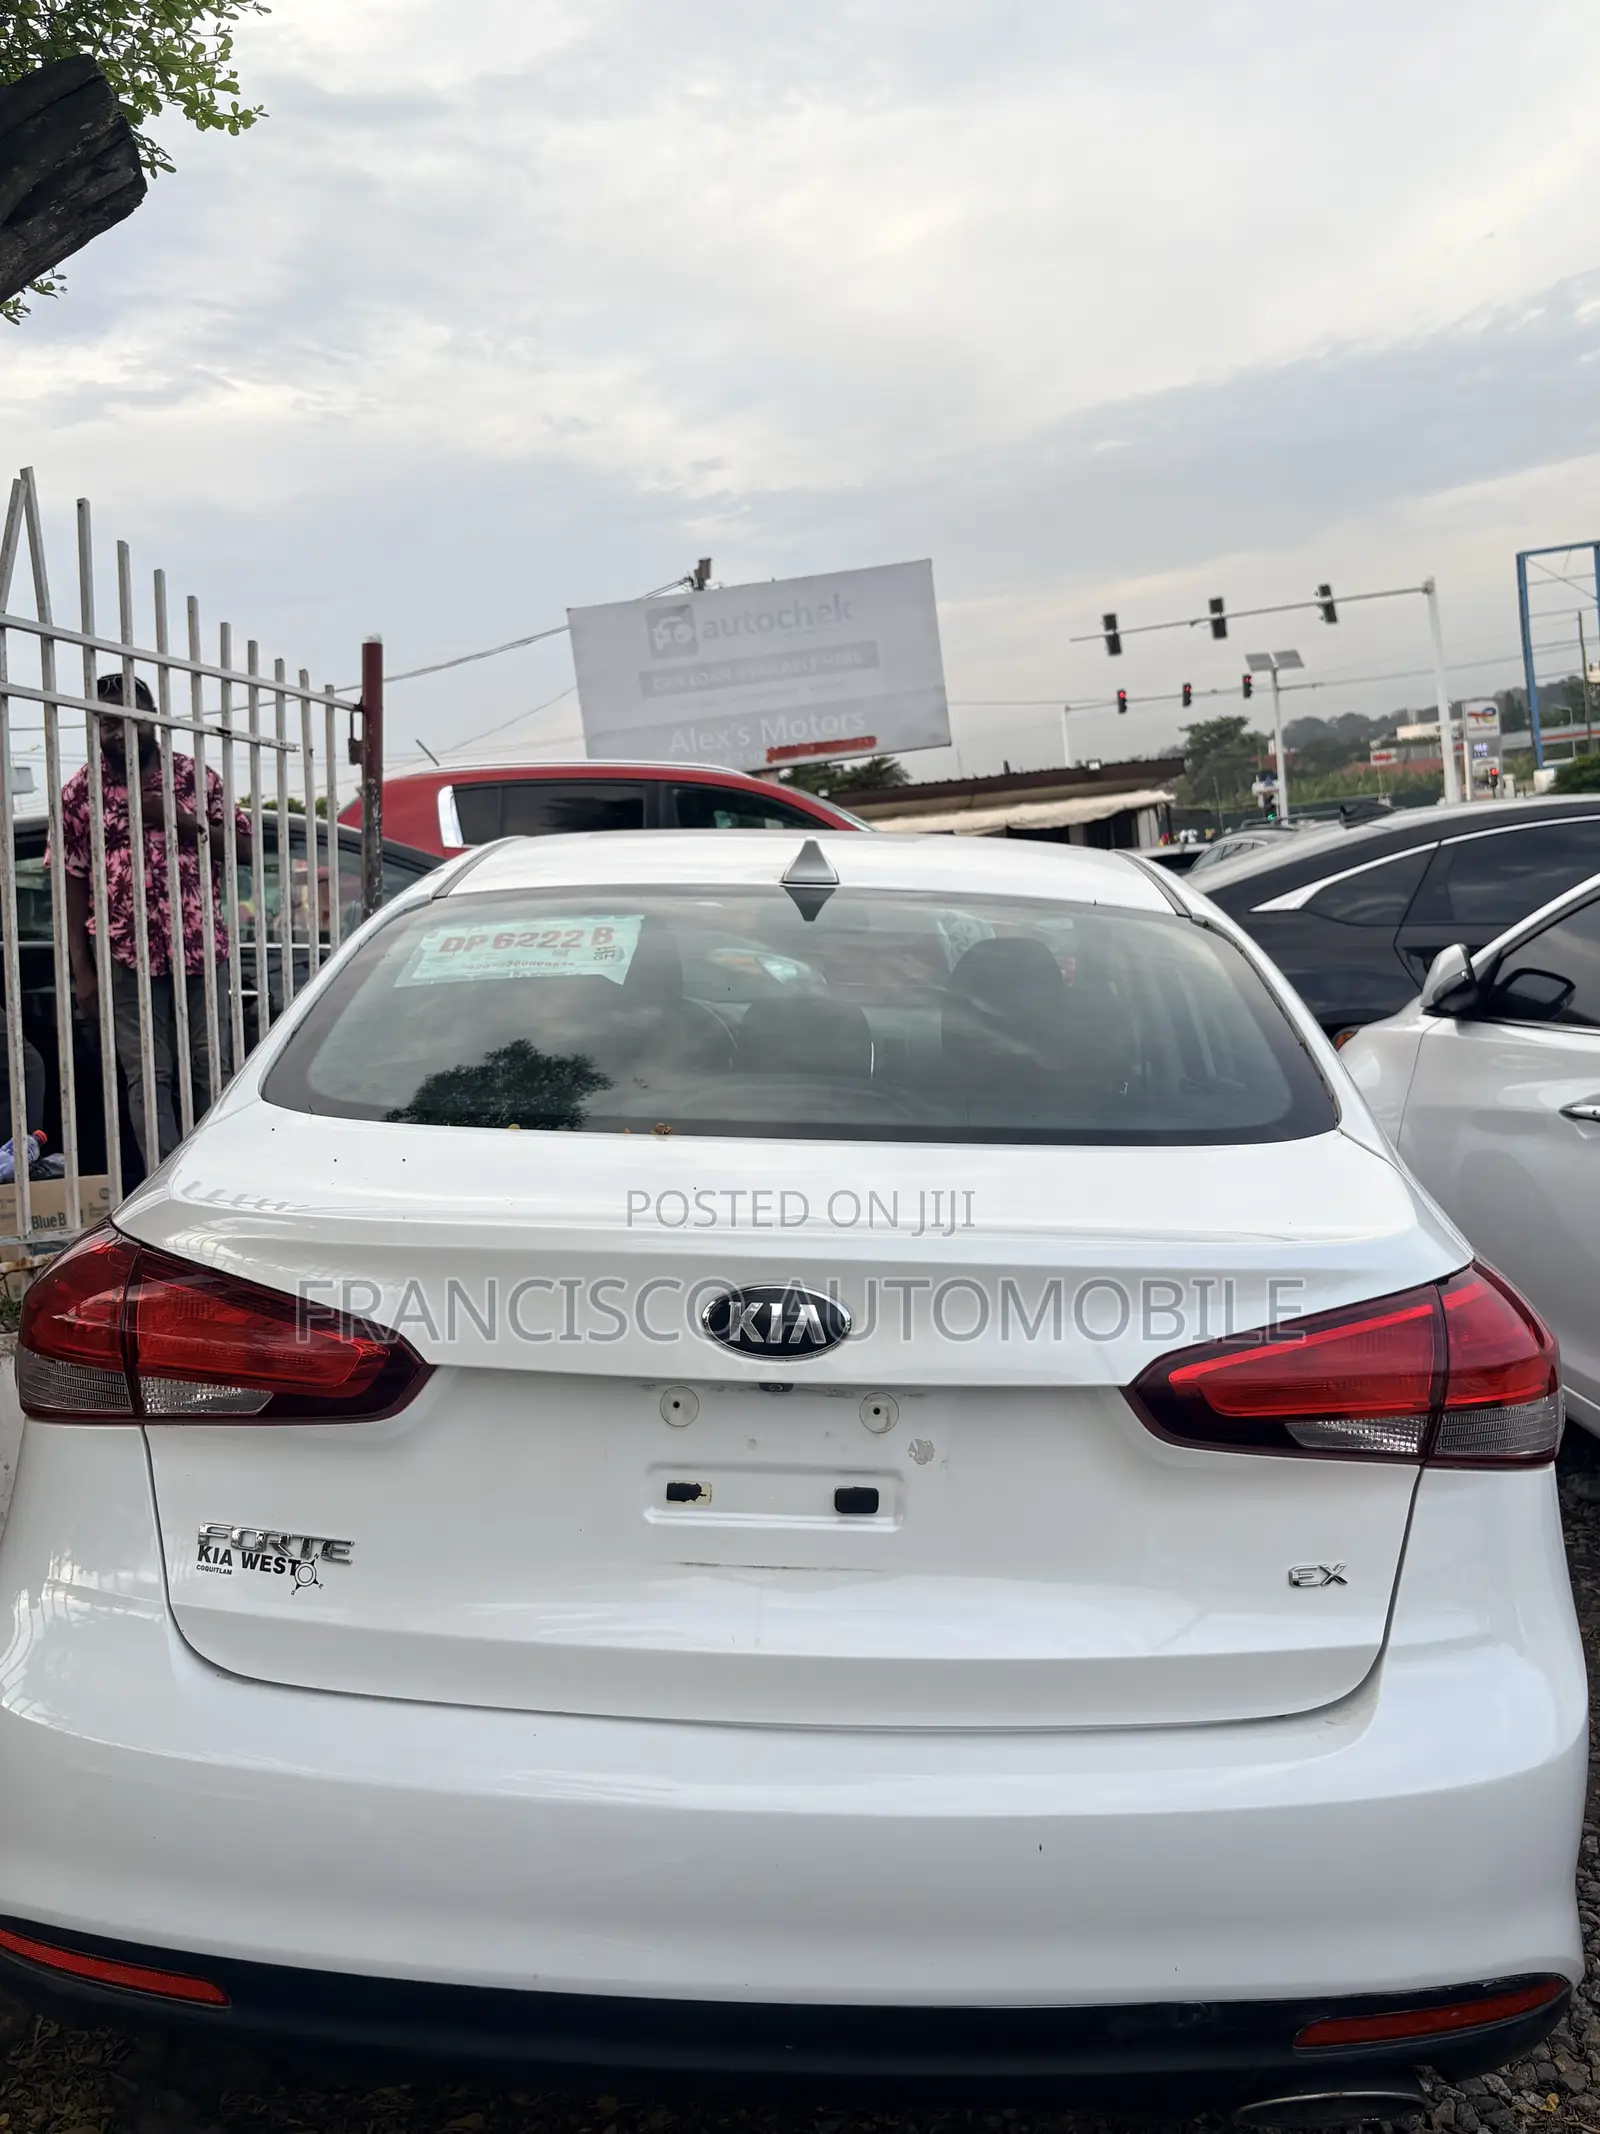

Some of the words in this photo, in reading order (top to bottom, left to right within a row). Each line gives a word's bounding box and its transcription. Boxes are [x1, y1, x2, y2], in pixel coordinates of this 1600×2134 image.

[702, 594, 852, 640] autochek
[670, 725, 750, 753] Alex's
[760, 711, 865, 744] Motors
[438, 934, 487, 952] DP
[492, 929, 585, 950] 6222
[591, 926, 615, 946] B
[31, 1215, 57, 1230] Blue
[728, 1301, 827, 1344] KIA
[198, 1522, 354, 1565] FORTE
[196, 1564, 233, 1575] COQUITLAM
[197, 1544, 233, 1567] KIA
[241, 1552, 302, 1577] WEST
[1288, 1562, 1348, 1588] EX
